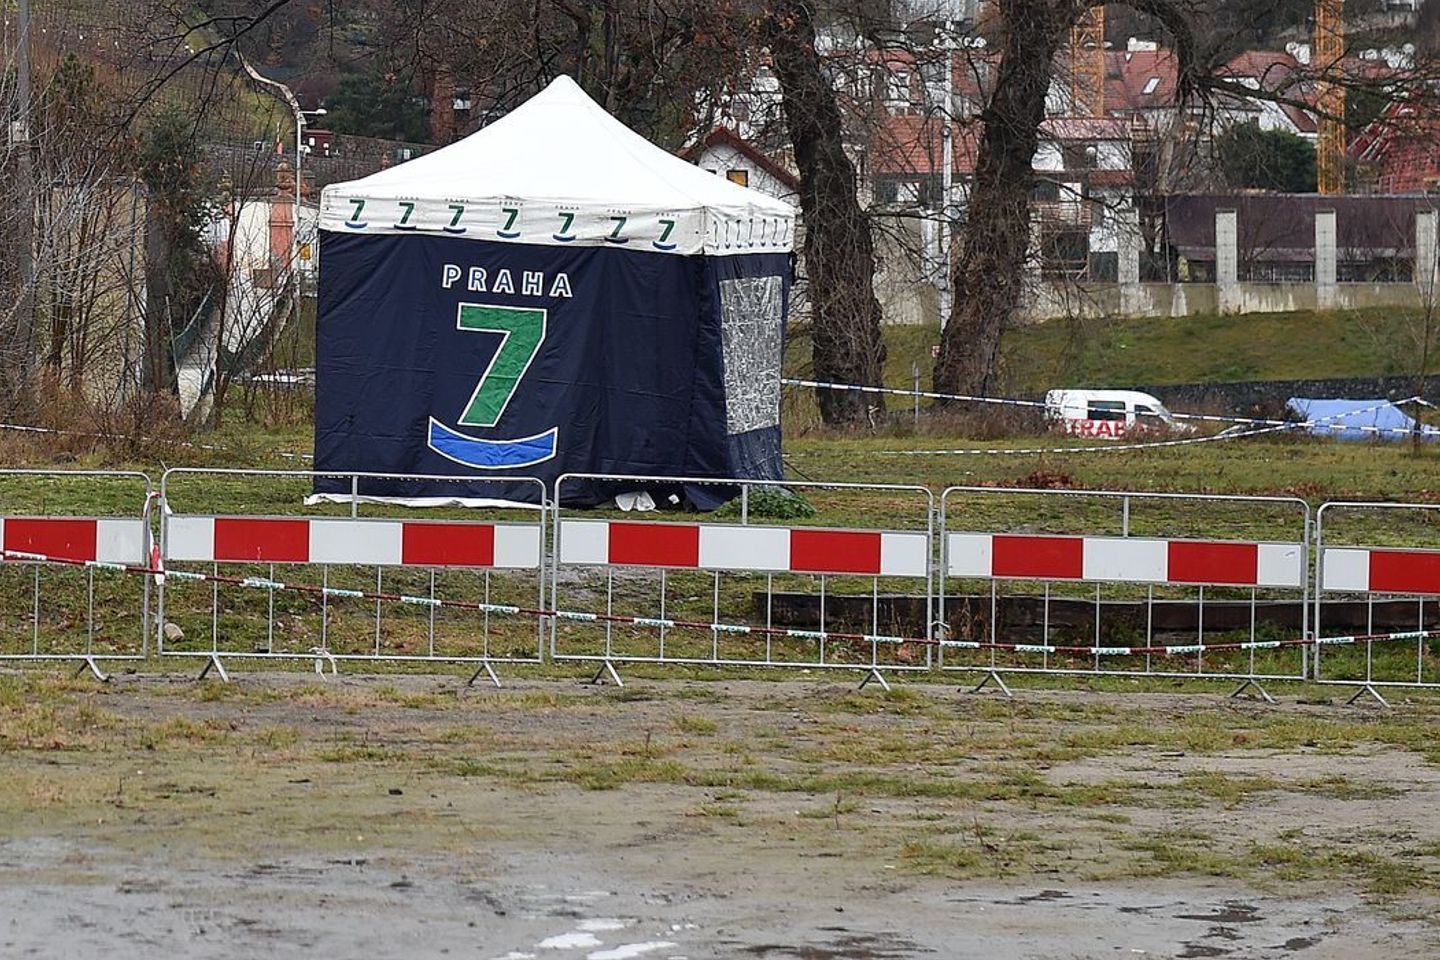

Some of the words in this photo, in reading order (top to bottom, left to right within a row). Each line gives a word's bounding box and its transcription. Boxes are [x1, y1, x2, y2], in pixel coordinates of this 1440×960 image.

[349, 198, 366, 221] 7
[398, 201, 415, 224] 7
[448, 204, 465, 227] 7
[501, 208, 519, 231] 7
[558, 212, 575, 235] 7
[609, 216, 627, 239] 7
[658, 220, 676, 243] 7
[441, 263, 574, 298] PRAHA
[456, 301, 548, 428] 7
